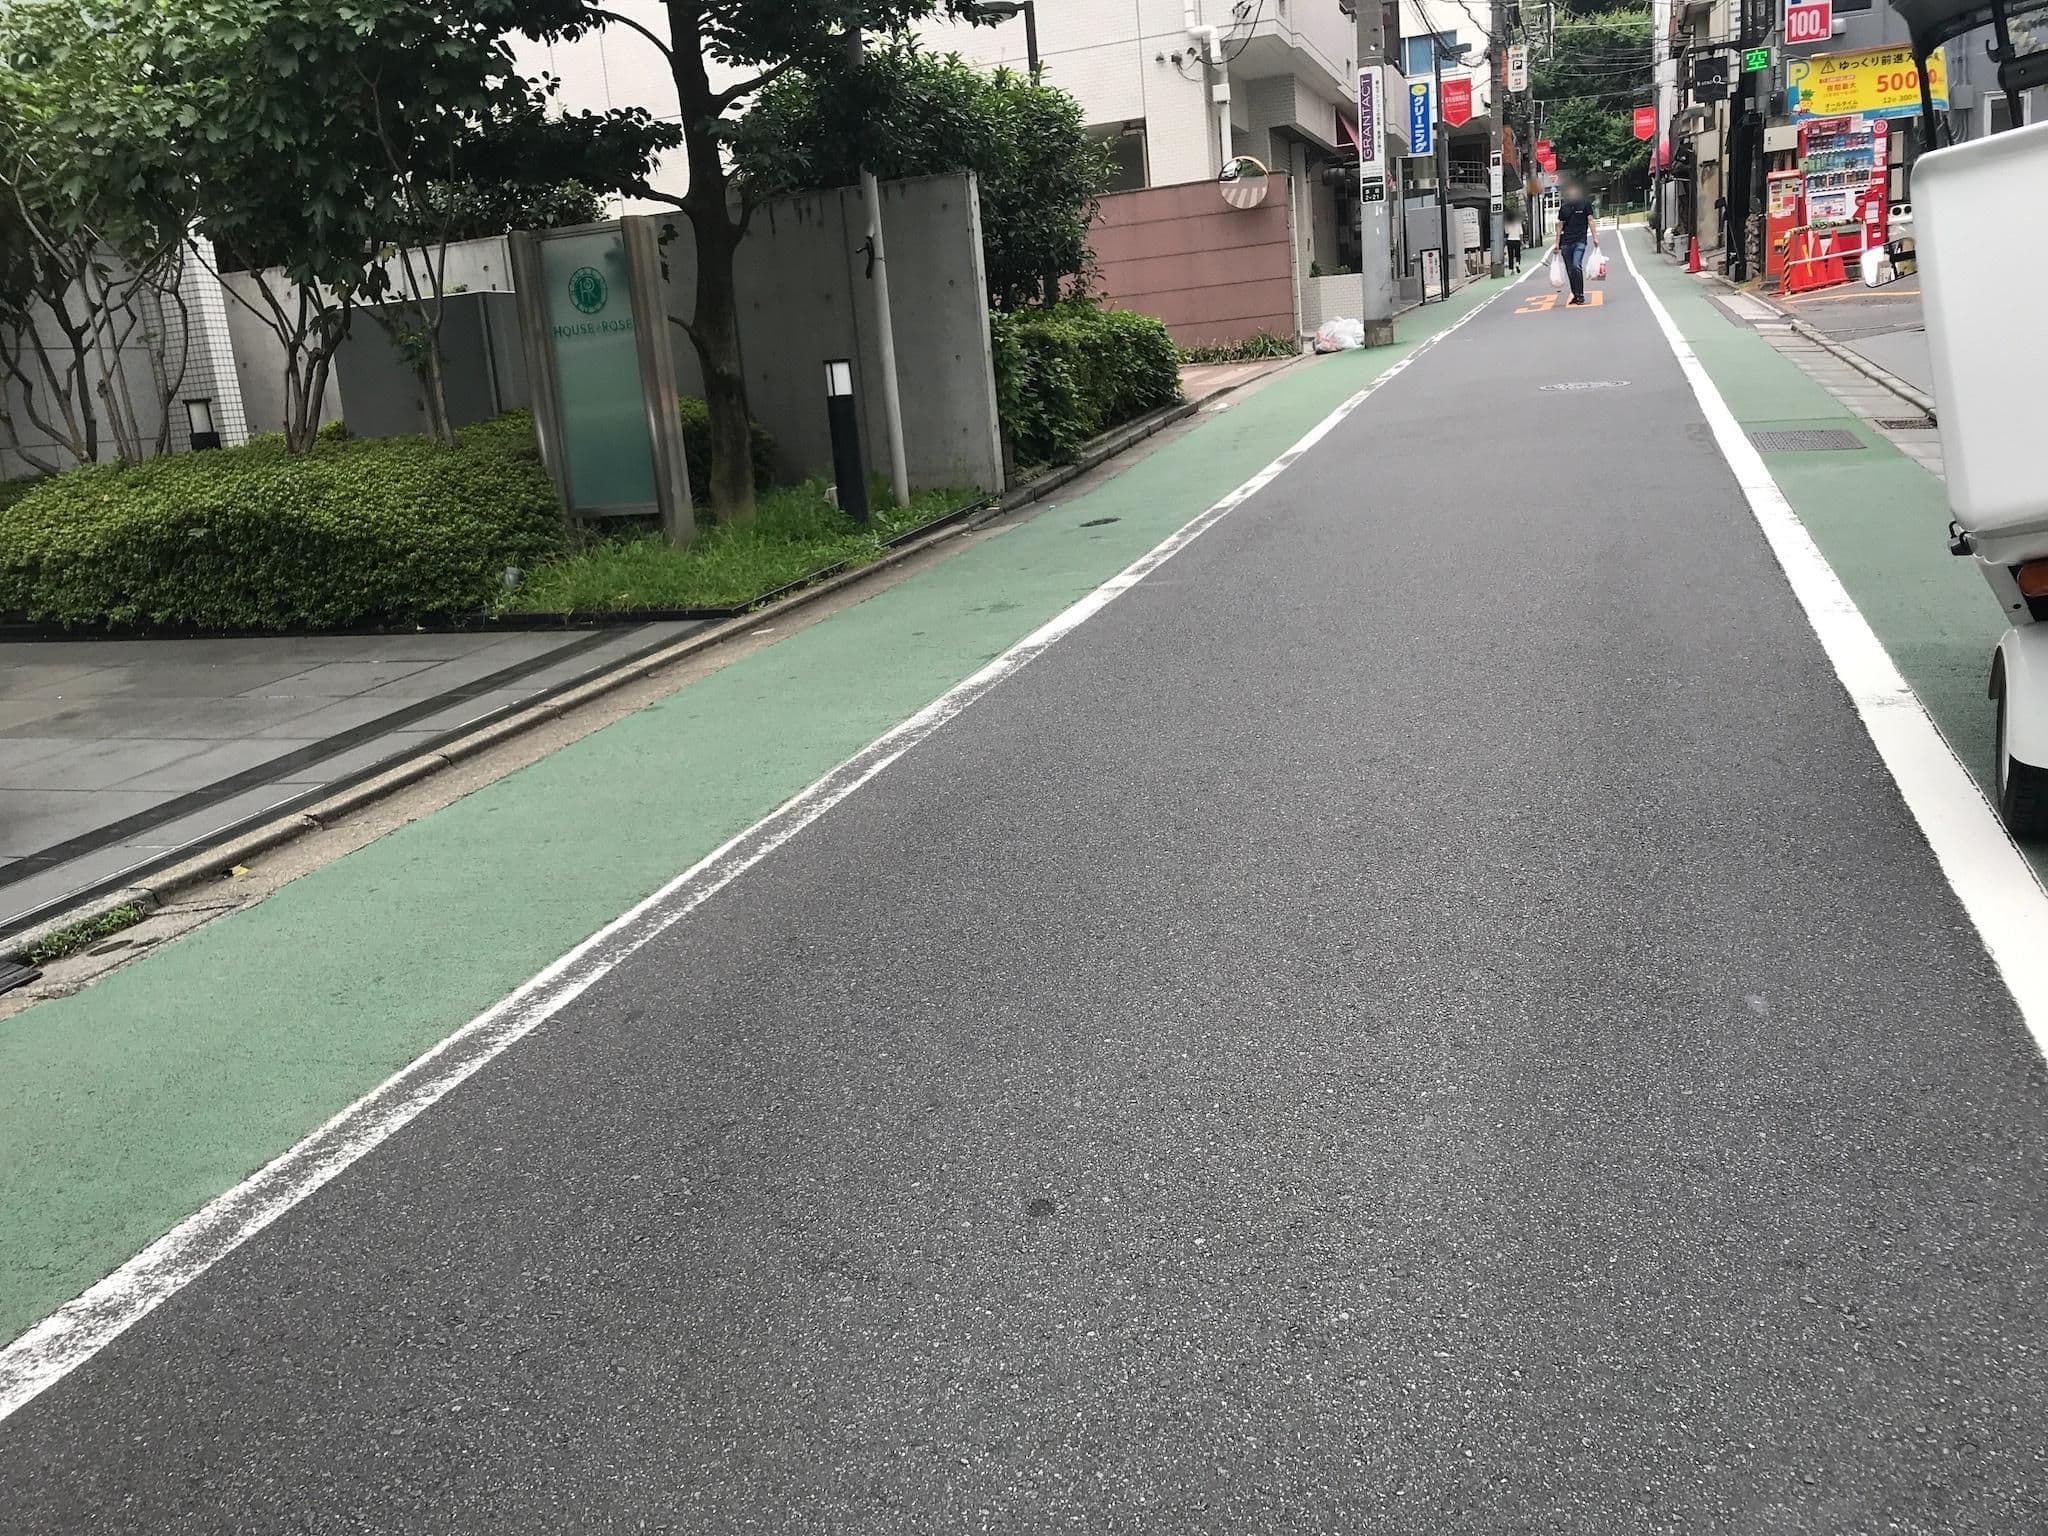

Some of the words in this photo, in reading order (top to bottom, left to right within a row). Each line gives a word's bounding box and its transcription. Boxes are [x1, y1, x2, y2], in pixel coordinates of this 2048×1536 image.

[1745, 49, 1768, 71] 空
[1361, 78, 1374, 160] GRANTACT
[1413, 95, 1428, 154] クリーニング
[553, 322, 594, 337] HOUSE
[601, 319, 633, 334] ROSE
